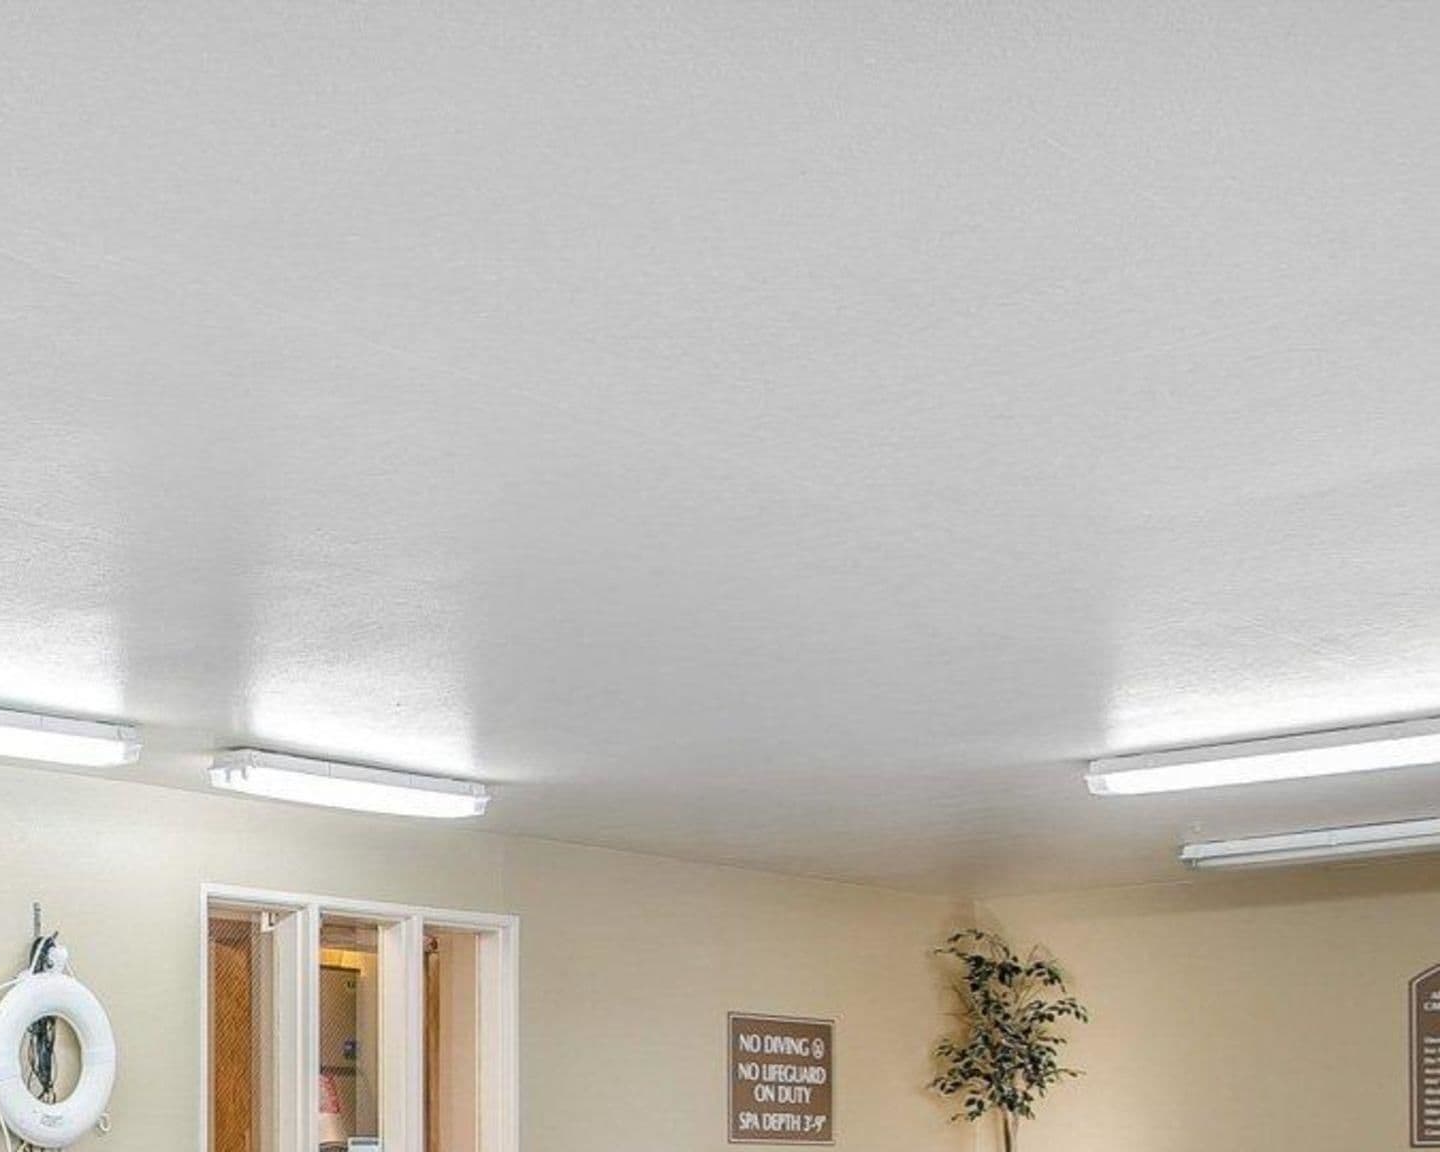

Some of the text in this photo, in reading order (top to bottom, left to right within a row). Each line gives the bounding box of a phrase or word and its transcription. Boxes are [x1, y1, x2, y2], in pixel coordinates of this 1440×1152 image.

[739, 1033, 810, 1057] NO DIVING
[737, 1062, 827, 1085] NO LIFEGUARD
[754, 1084, 813, 1104] ON DUTY
[738, 1111, 760, 1131] SPA
[762, 1113, 801, 1132] DEPTH
